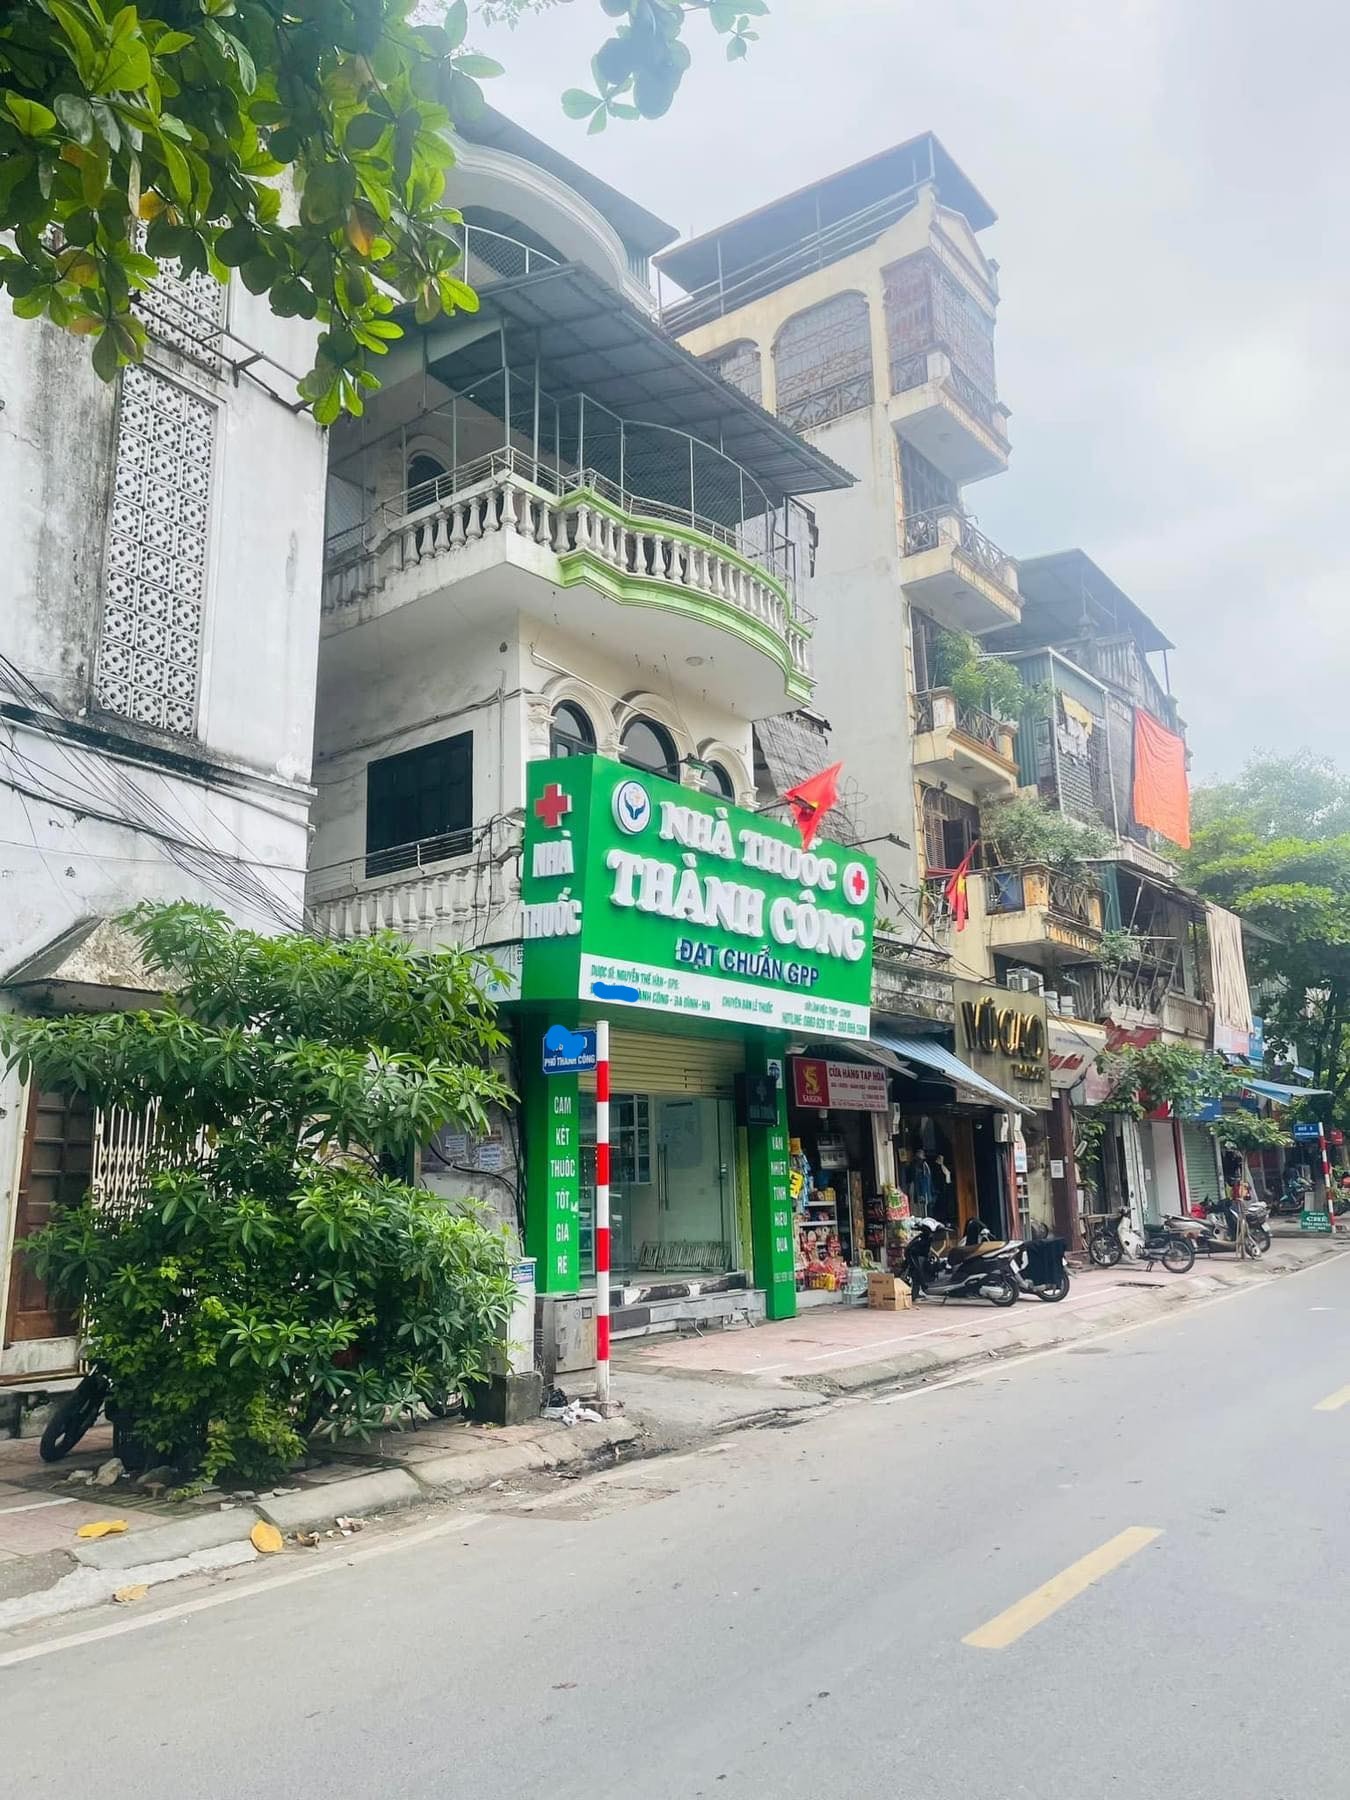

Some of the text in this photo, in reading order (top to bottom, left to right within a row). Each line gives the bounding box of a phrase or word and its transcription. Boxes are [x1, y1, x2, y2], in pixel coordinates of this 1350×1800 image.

[532, 830, 575, 878] NHÀ
[659, 801, 838, 890] NHÀ THUỐC
[521, 887, 583, 939] THUỐC
[606, 849, 866, 962] THÀNH CÔNG
[676, 937, 820, 988] ĐẠT CHUẨN GPP
[550, 1153, 576, 1178] THUỐC
